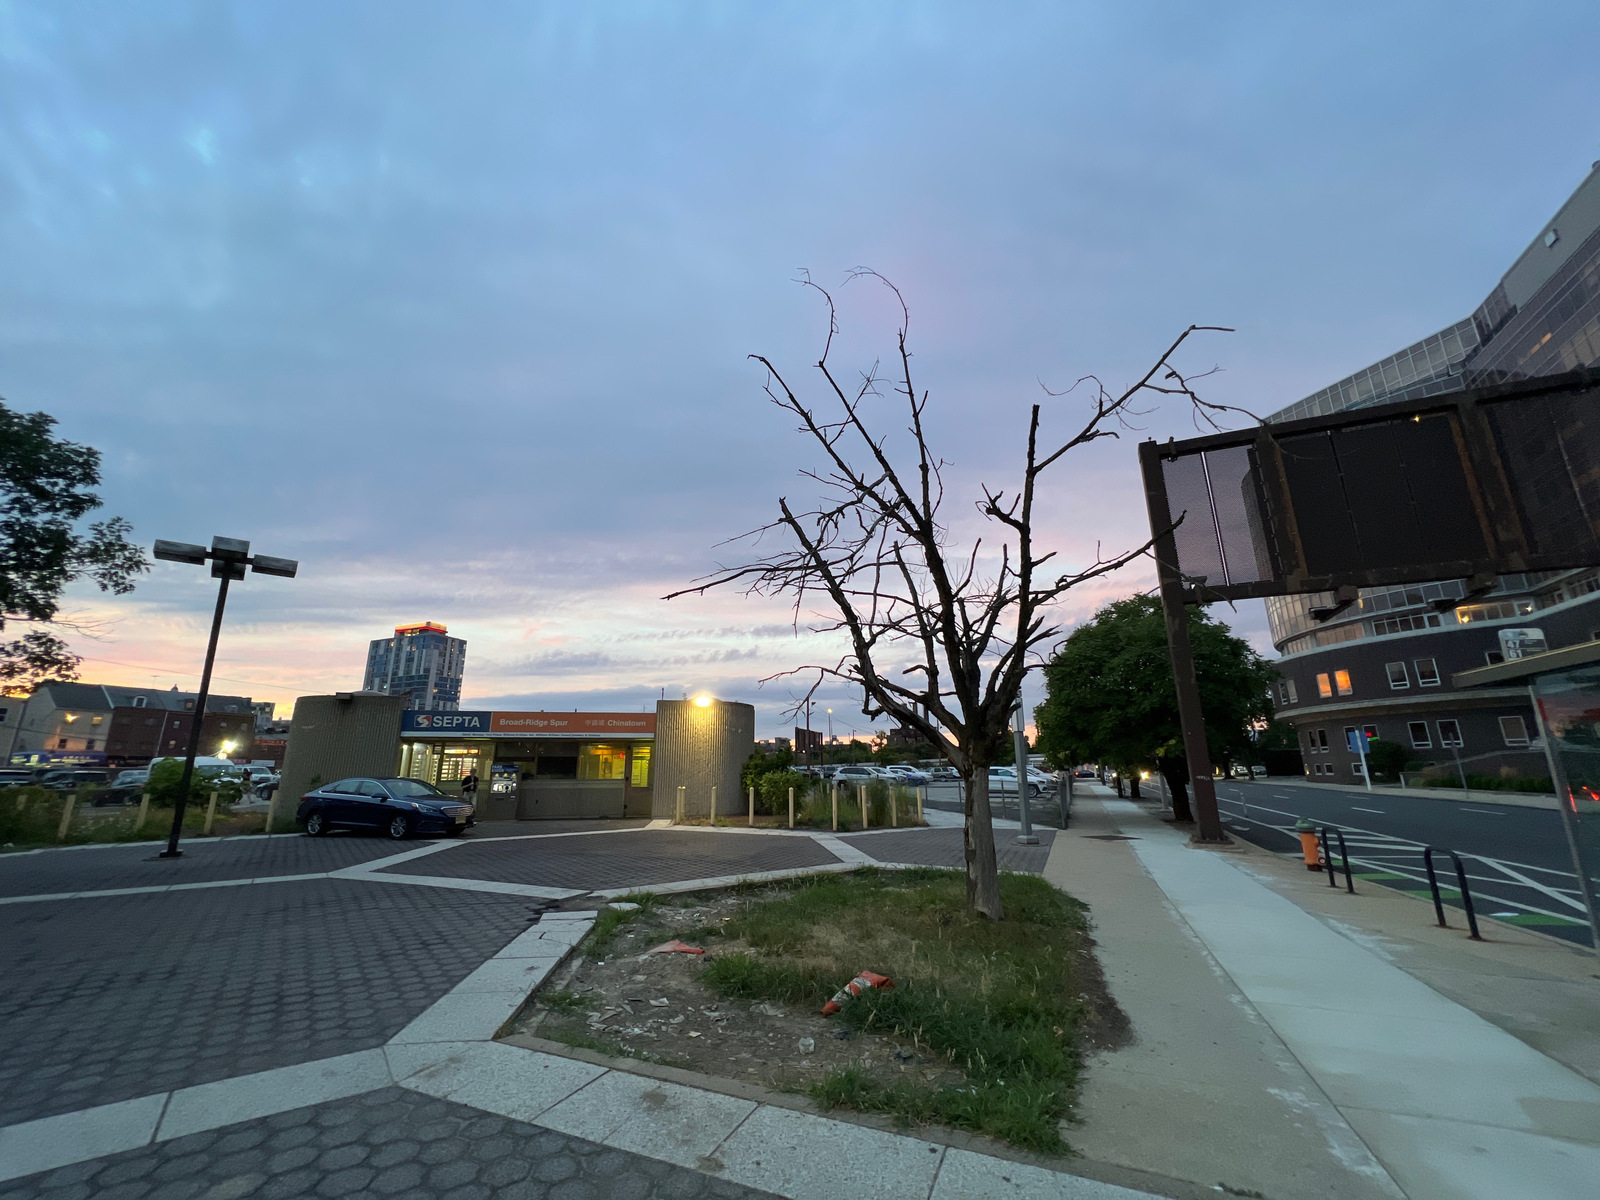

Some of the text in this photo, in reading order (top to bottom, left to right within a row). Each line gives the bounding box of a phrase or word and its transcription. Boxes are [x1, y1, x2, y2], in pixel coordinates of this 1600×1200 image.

[1507, 640, 1520, 648] 47
[1509, 649, 1522, 658] 61
[432, 716, 480, 727] SEPTA
[500, 719, 568, 727] Broad-Ridge Spur
